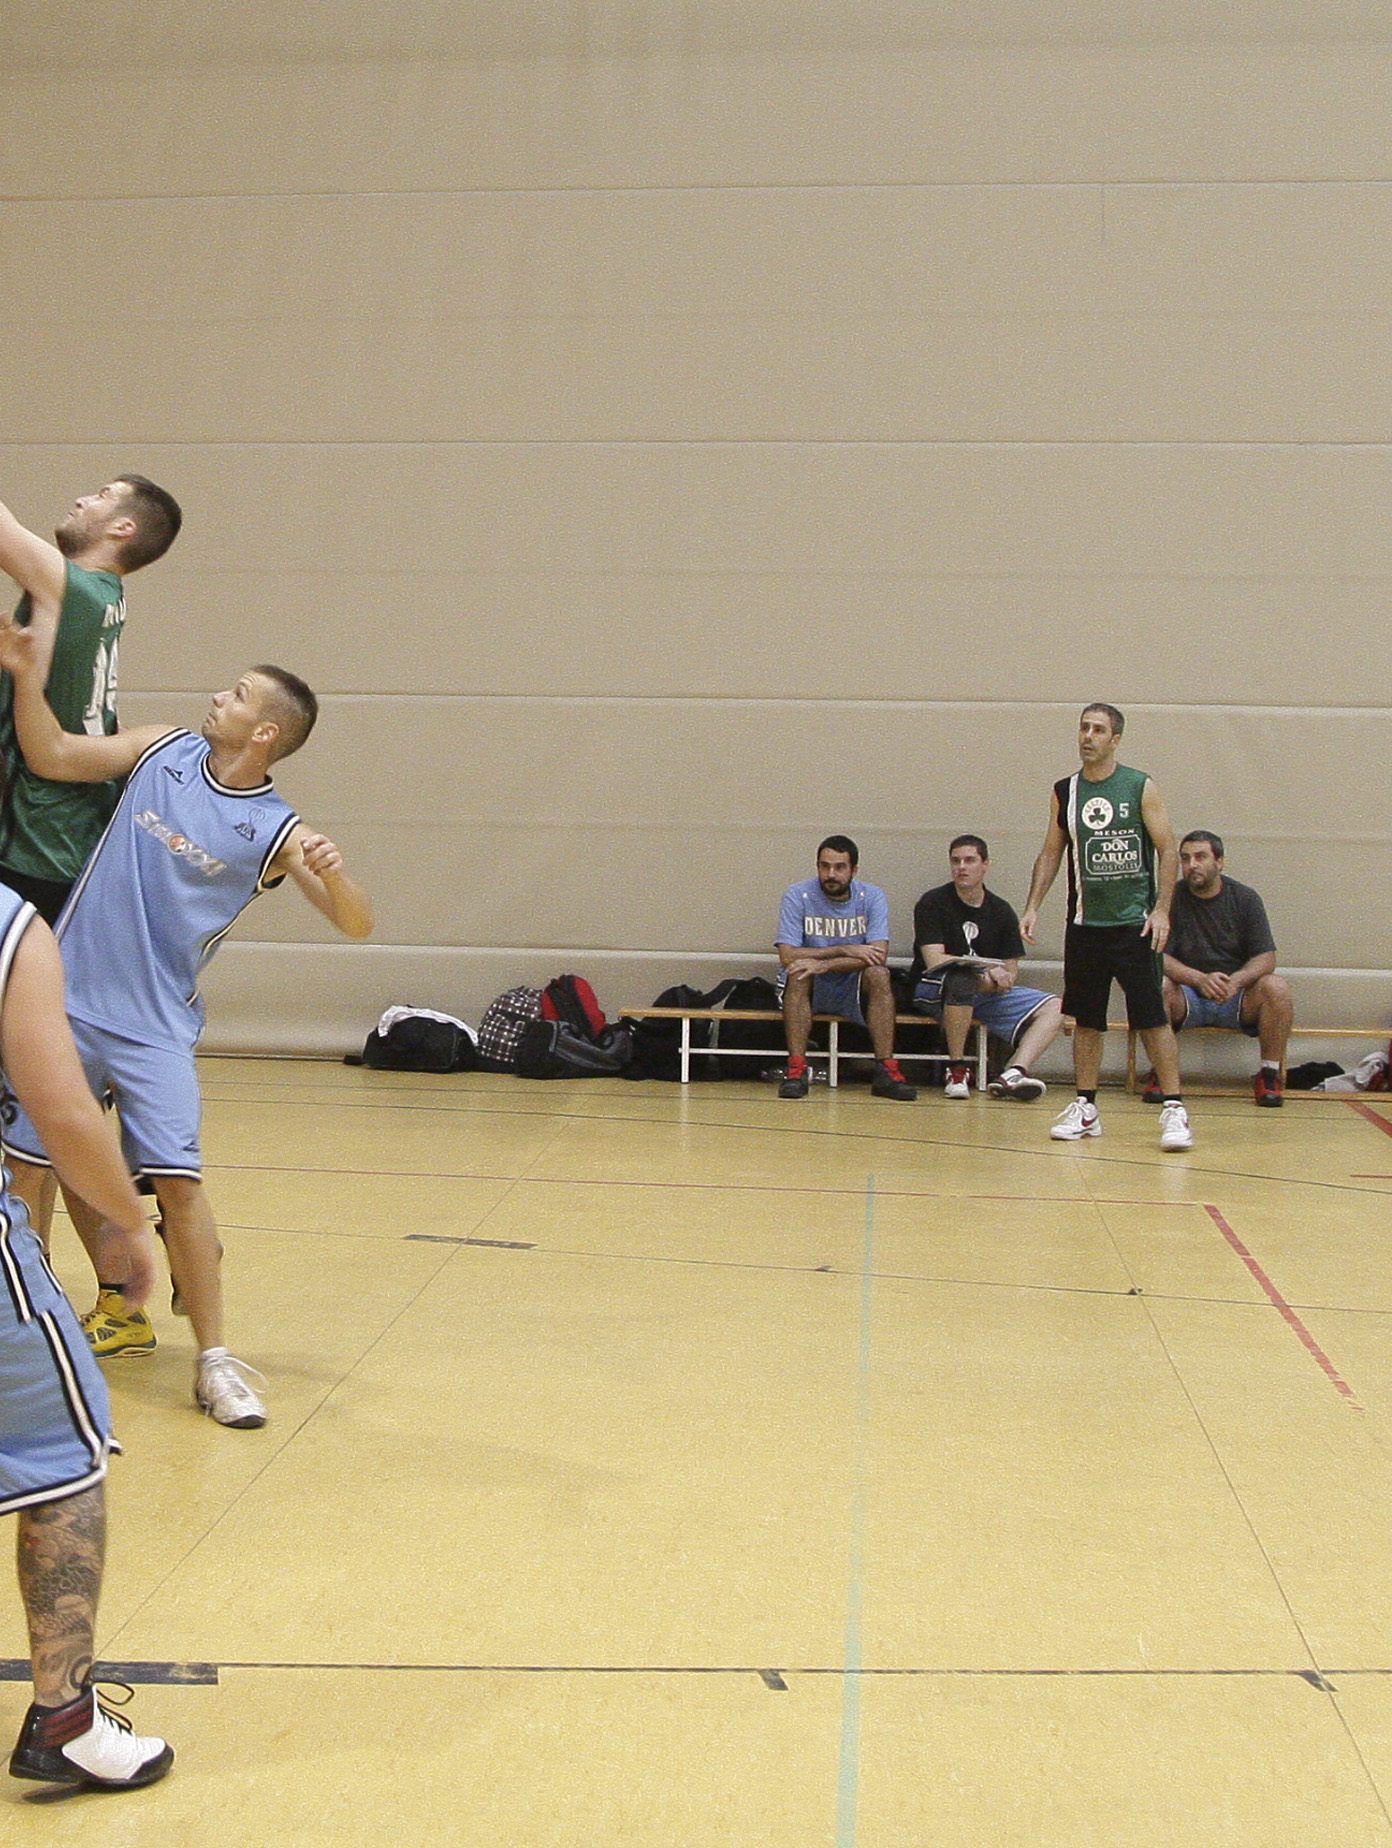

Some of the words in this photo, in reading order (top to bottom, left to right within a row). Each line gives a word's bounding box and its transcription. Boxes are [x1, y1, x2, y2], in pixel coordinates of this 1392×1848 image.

[1119, 803, 1129, 818] 5
[1094, 828, 1135, 836] MESON
[1101, 838, 1128, 851] DON
[1092, 850, 1138, 864] CARLOS
[804, 915, 868, 938] DENVER
